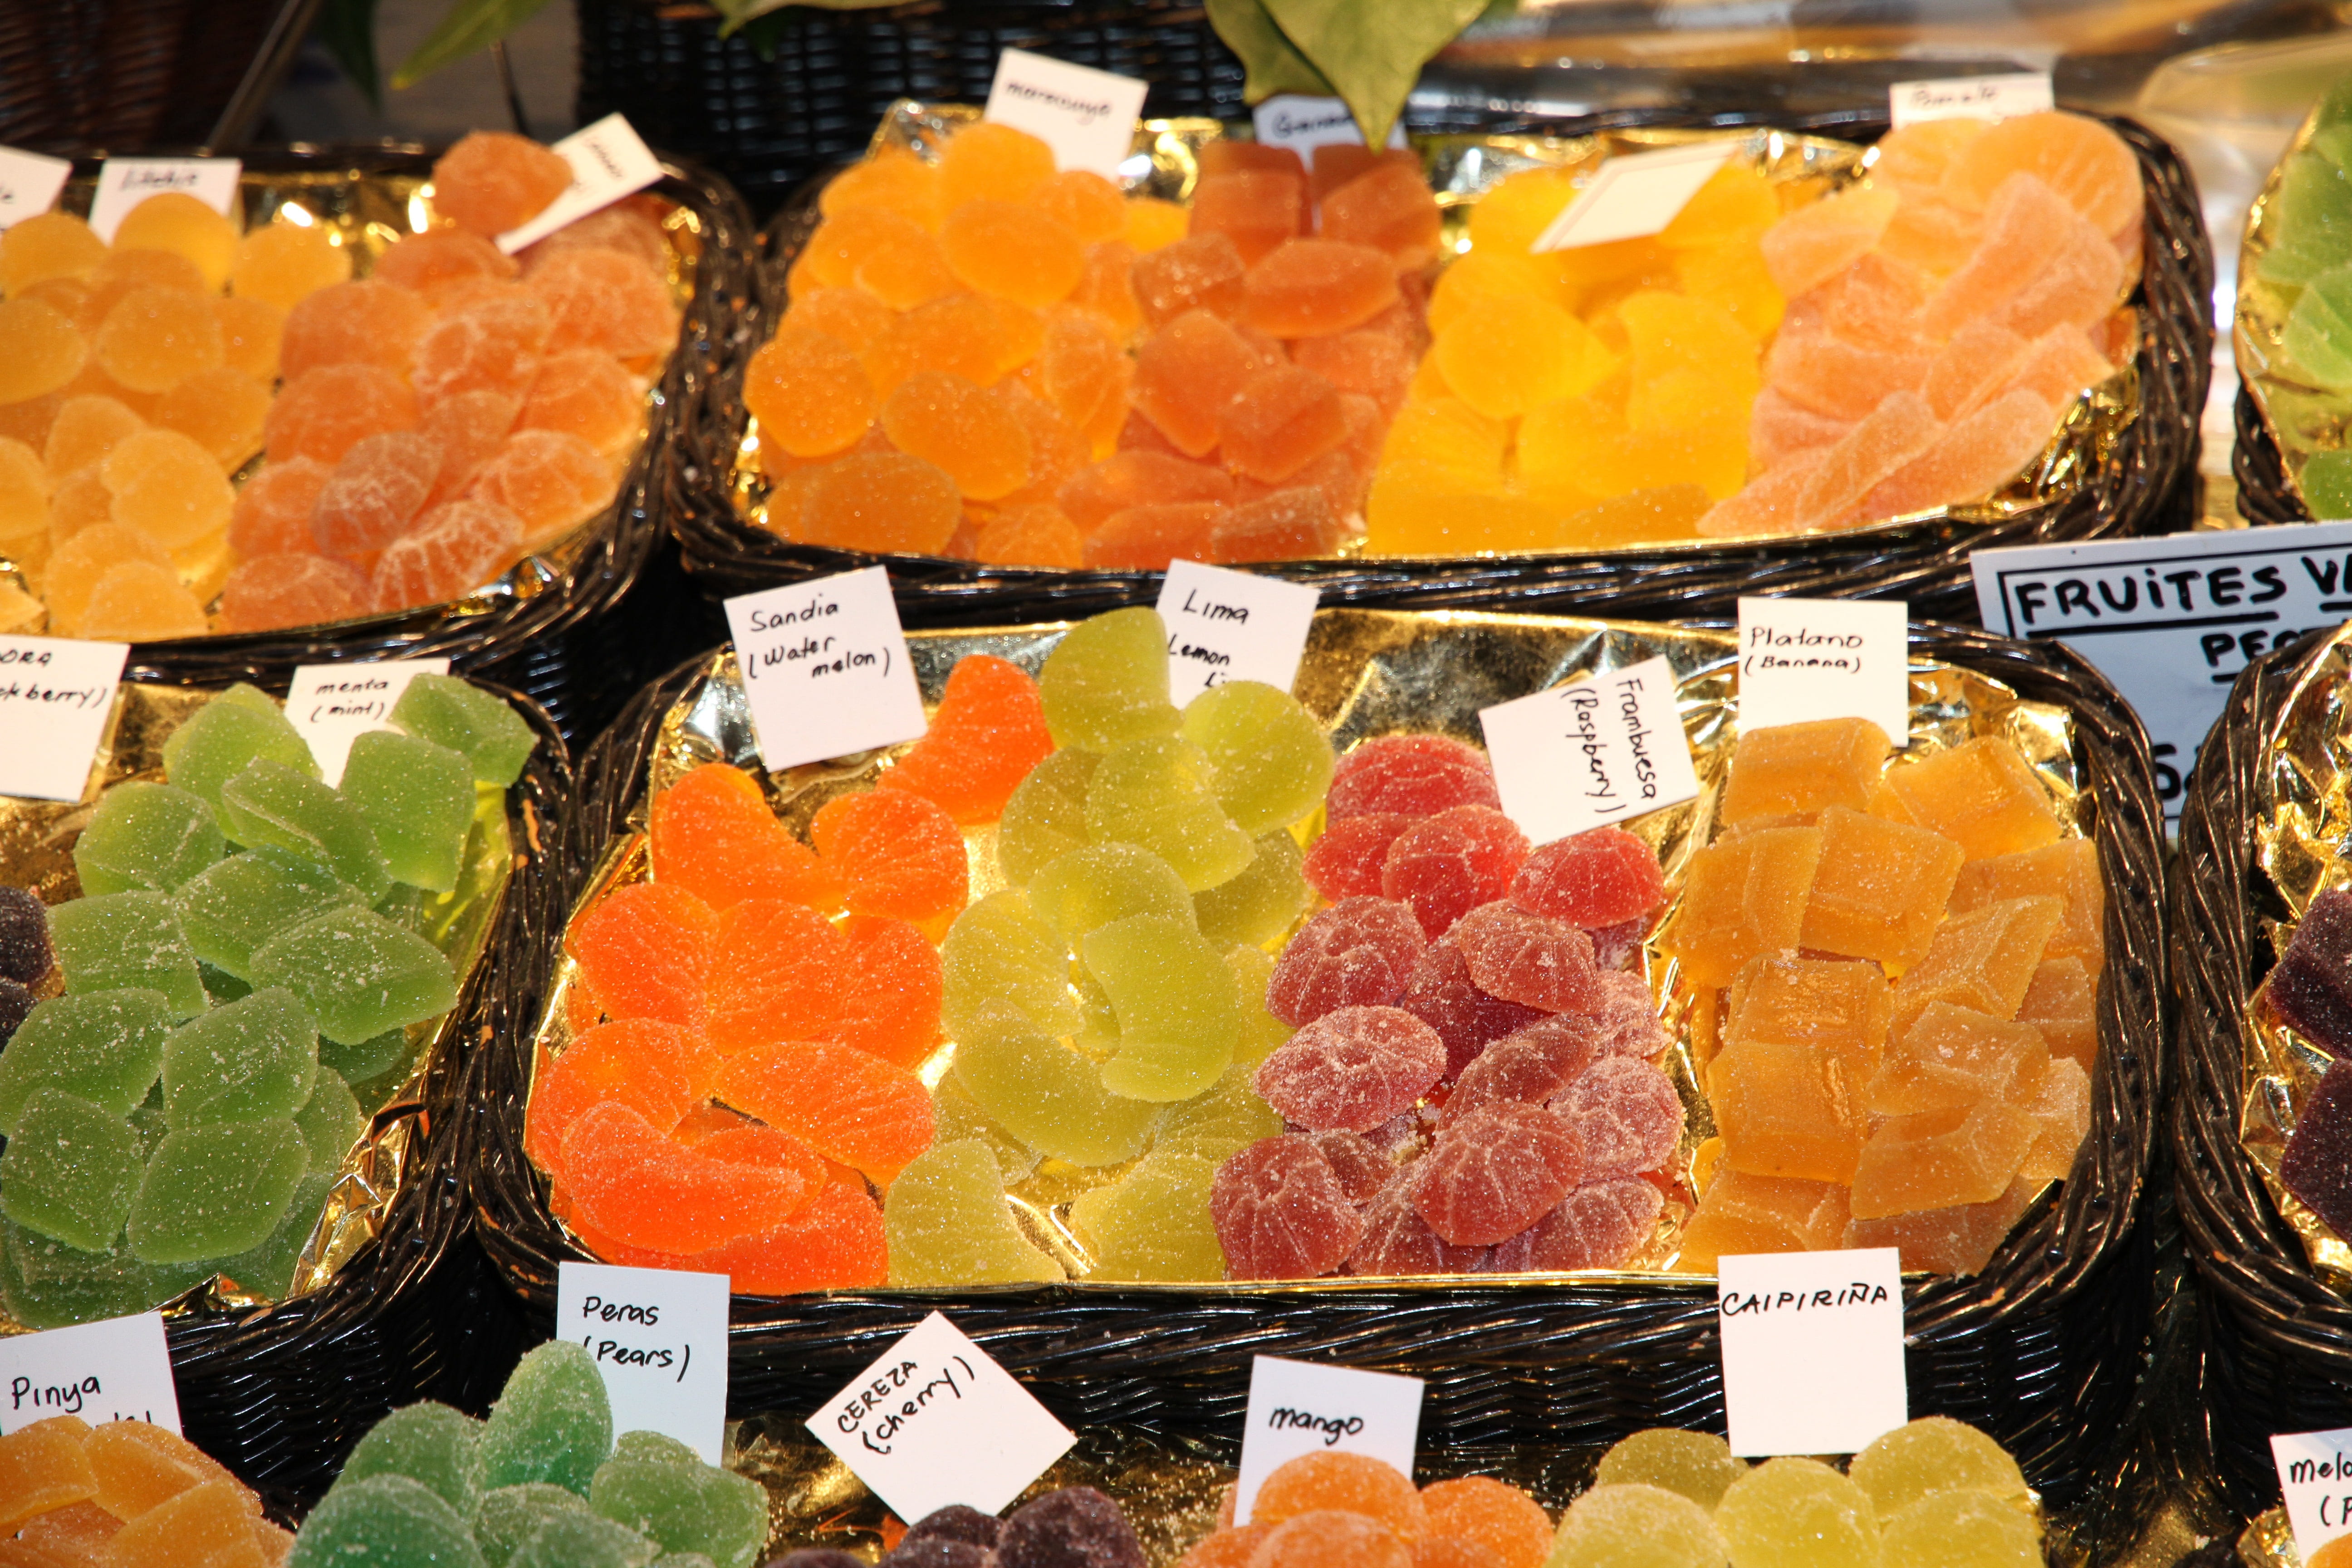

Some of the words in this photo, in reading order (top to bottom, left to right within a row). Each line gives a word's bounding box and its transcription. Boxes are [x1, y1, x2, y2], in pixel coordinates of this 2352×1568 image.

[750, 593, 838, 632] Sandia
[1182, 589, 1249, 624] Lima
[1750, 626, 1862, 648] Platano
[749, 636, 835, 679] (Water
[1744, 655, 1861, 677] (Banana)
[315, 678, 389, 696] menta
[310, 700, 385, 723] (mint)
[1616, 678, 1656, 799] Frambuesa
[583, 1296, 660, 1326] Peras
[1722, 1282, 1887, 1316] CAIPIRIÑA
[11, 1376, 101, 1414] Pinya
[837, 1362, 918, 1433] CEREZA
[1269, 1406, 1364, 1446] mango
